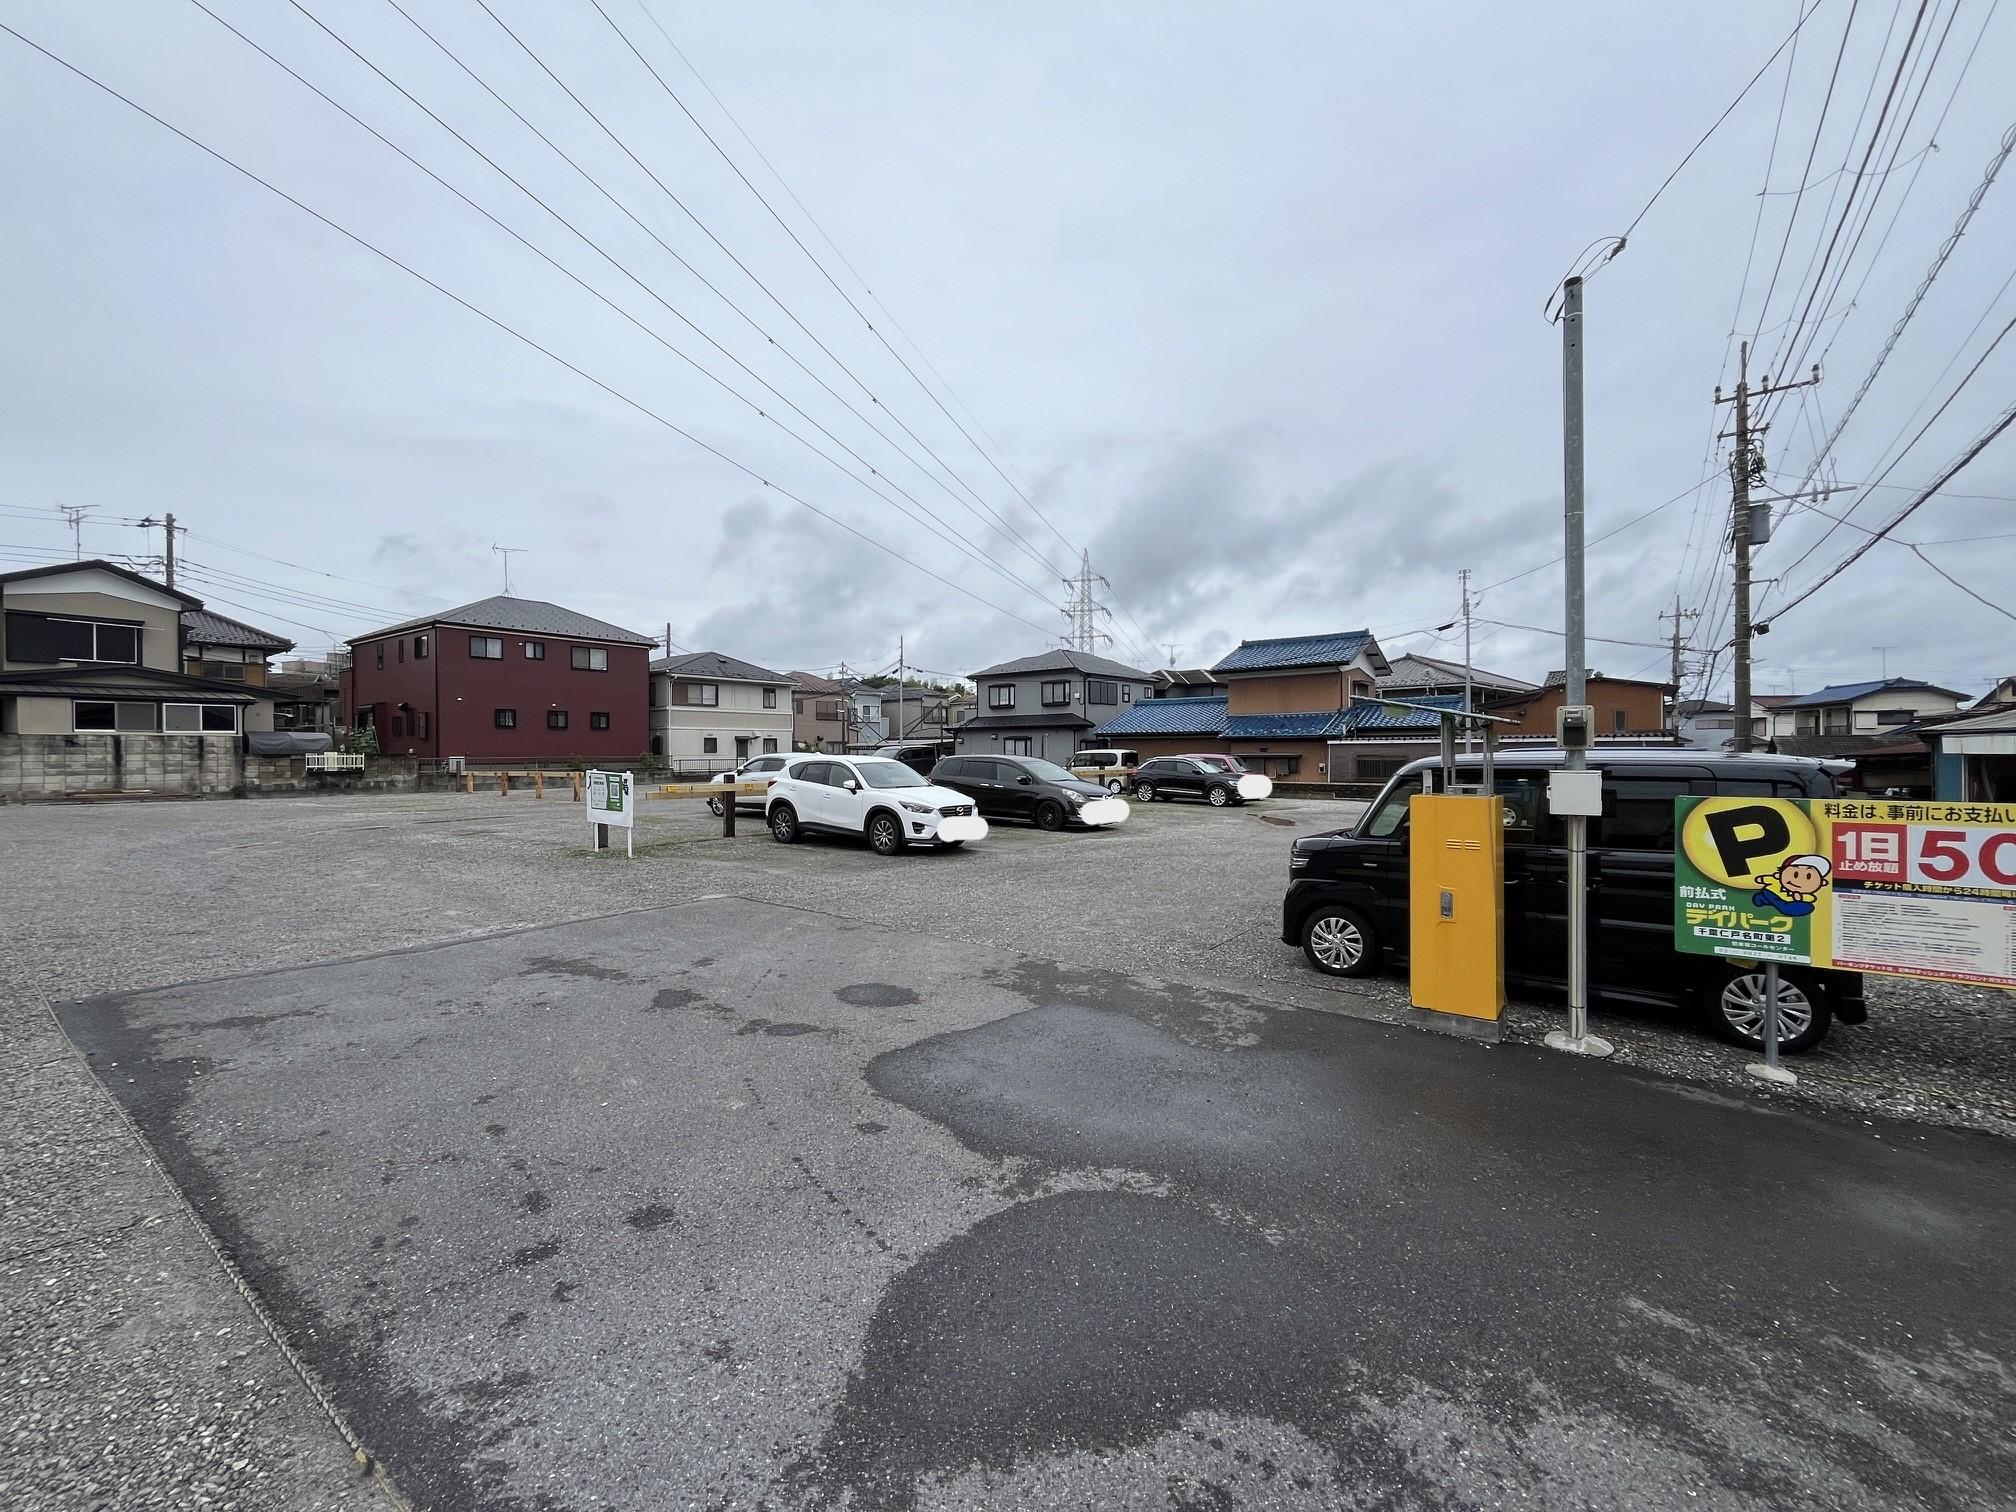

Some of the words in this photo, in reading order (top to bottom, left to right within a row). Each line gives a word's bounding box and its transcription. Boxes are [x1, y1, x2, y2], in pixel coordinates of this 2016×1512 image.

[1705, 805, 1791, 878] P
[1837, 831, 1899, 861] 1日
[1838, 861, 1899, 874] 止め放題
[1679, 886, 1727, 901] 前払式
[1686, 908, 1793, 933] デイパーク
